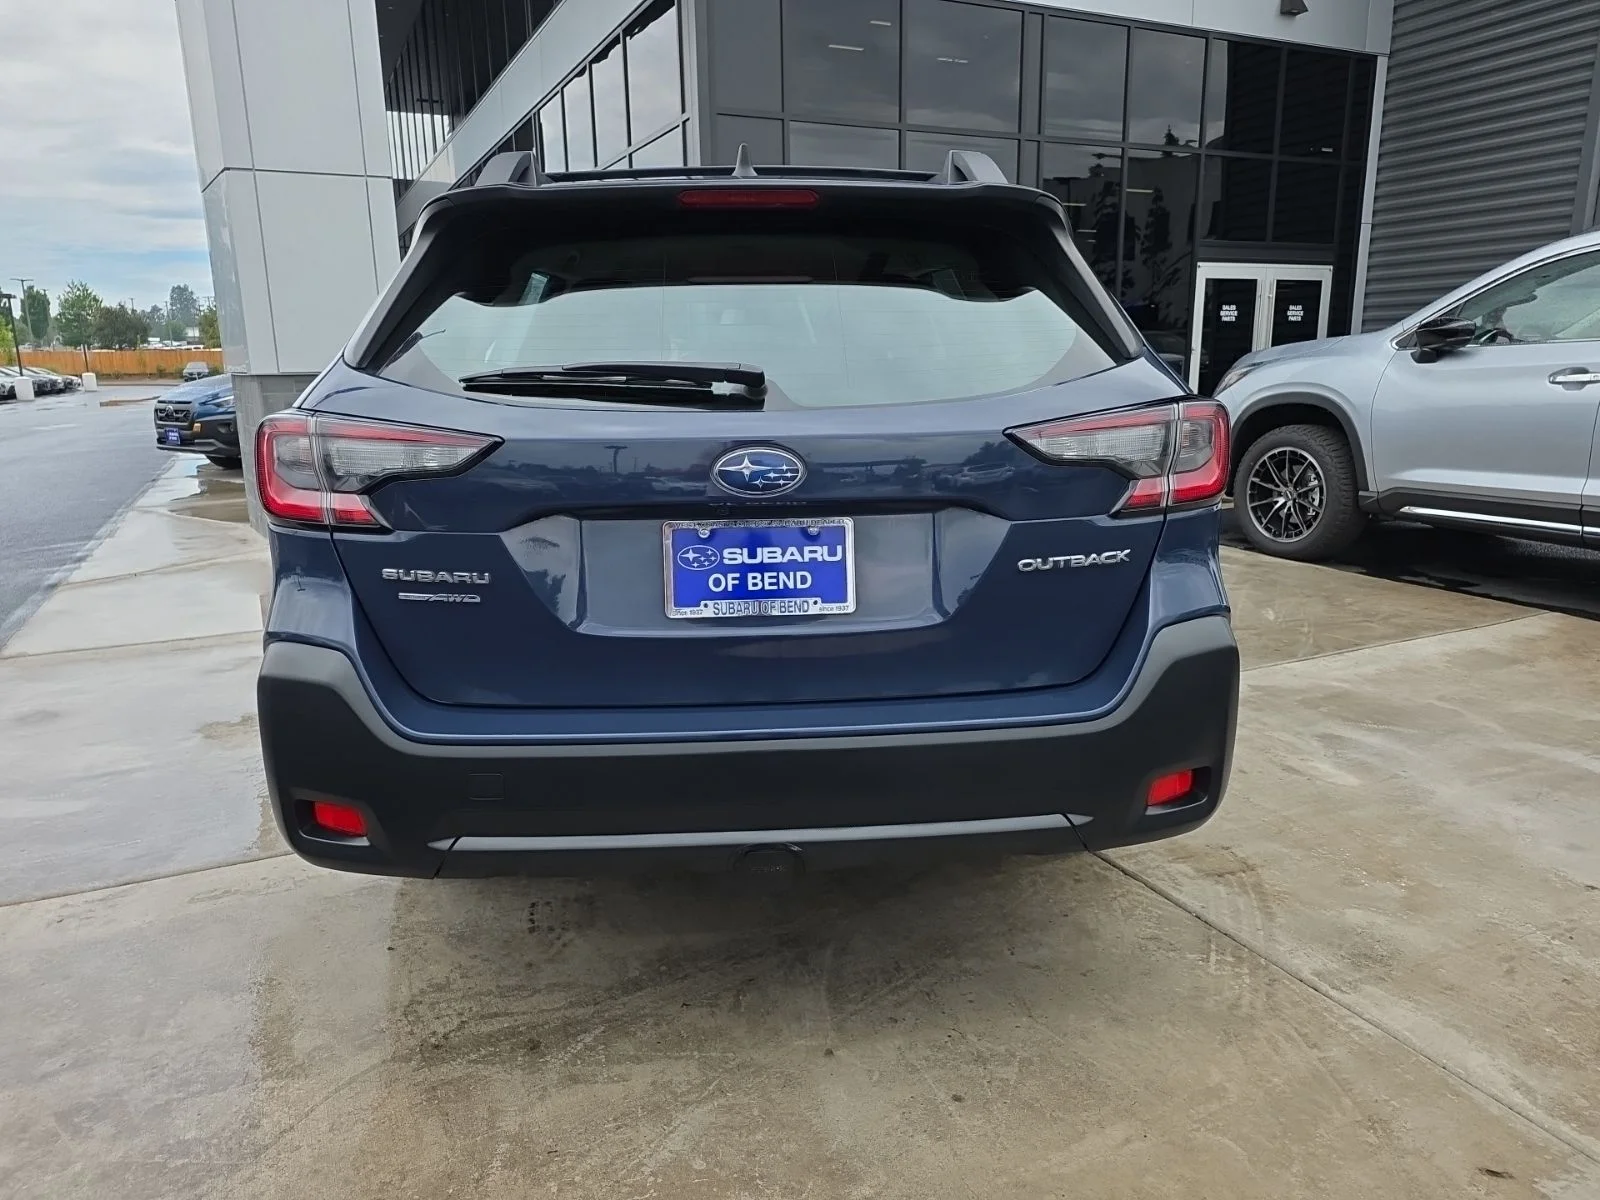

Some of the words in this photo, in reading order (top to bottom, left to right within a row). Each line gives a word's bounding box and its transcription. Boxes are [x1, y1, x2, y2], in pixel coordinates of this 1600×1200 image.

[723, 545, 843, 565] SUBARU
[1017, 549, 1131, 572] OUTBACK
[382, 568, 490, 584] SUBARU
[708, 573, 740, 592] OF
[747, 571, 812, 591] BEND
[428, 593, 481, 603] AWD
[713, 601, 758, 615] SUBARU
[761, 600, 776, 614] OF
[779, 600, 810, 613] BEND
